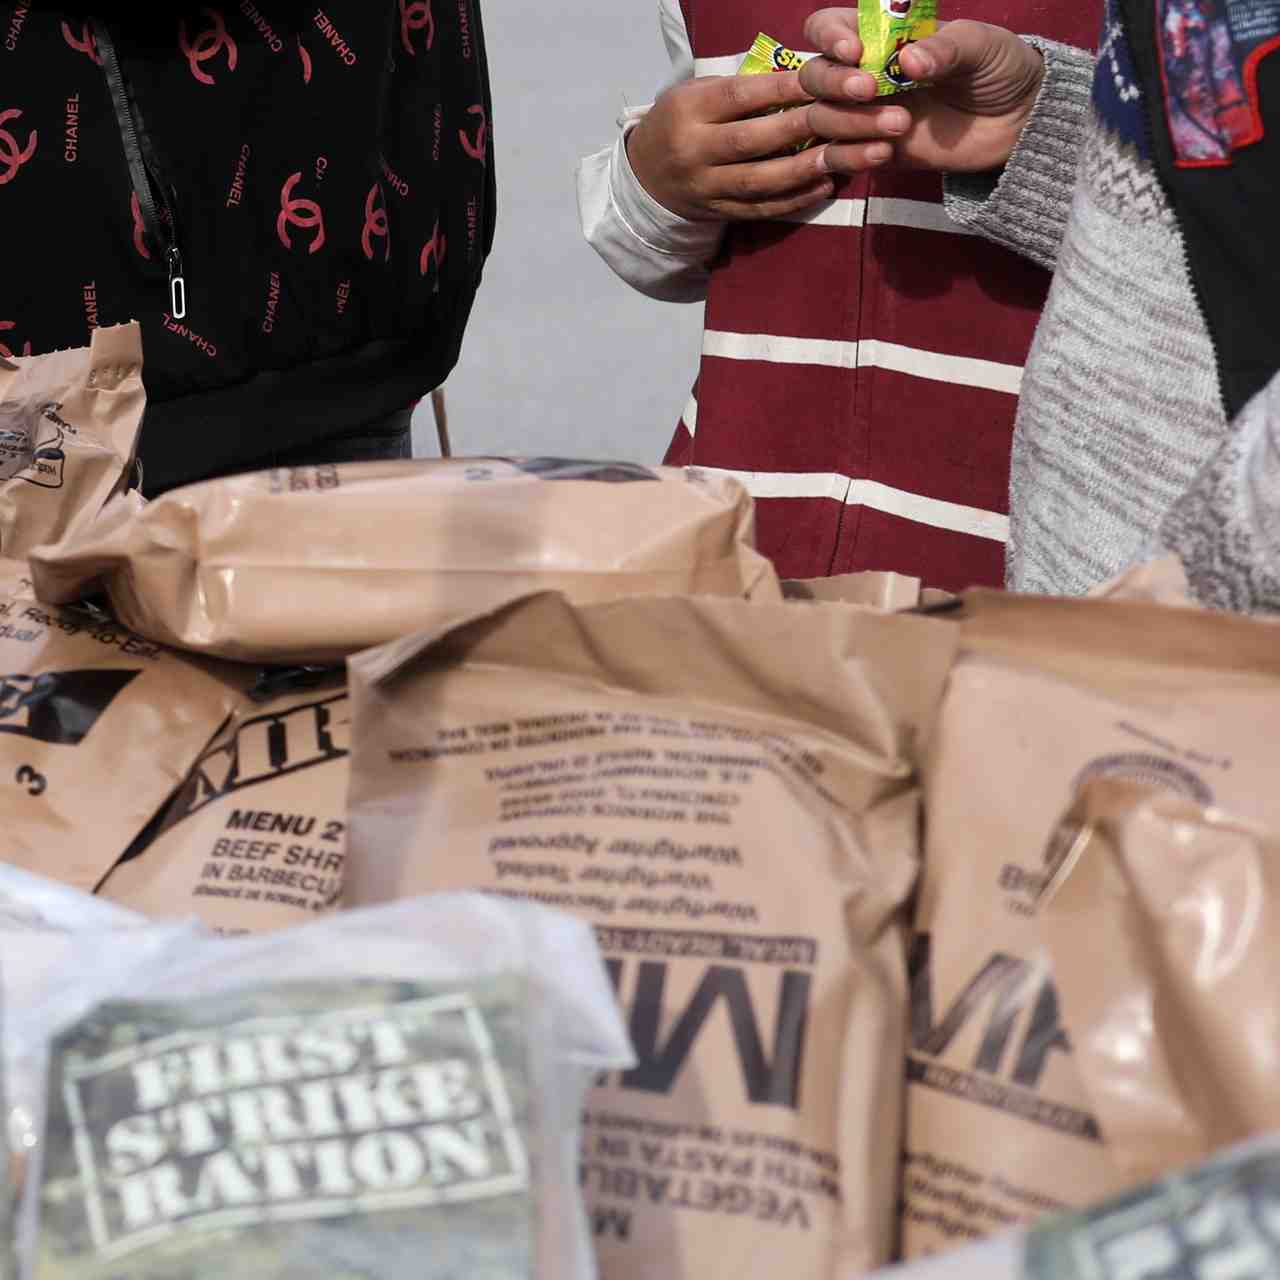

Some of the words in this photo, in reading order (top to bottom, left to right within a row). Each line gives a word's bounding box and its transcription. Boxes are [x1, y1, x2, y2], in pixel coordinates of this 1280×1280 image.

[311, 7, 358, 66] CHANEL
[64, 92, 81, 162] CHANEL
[160, 312, 217, 359] CHANEL
[15, 764, 48, 797] 3
[211, 837, 281, 861] BEEF
[225, 808, 317, 837] MENU
[320, 821, 344, 842] 2
[200, 862, 224, 880] IN
[132, 1013, 430, 1109] FIRST
[105, 1057, 482, 1176] STRIKE
[118, 1117, 491, 1228] RATION
